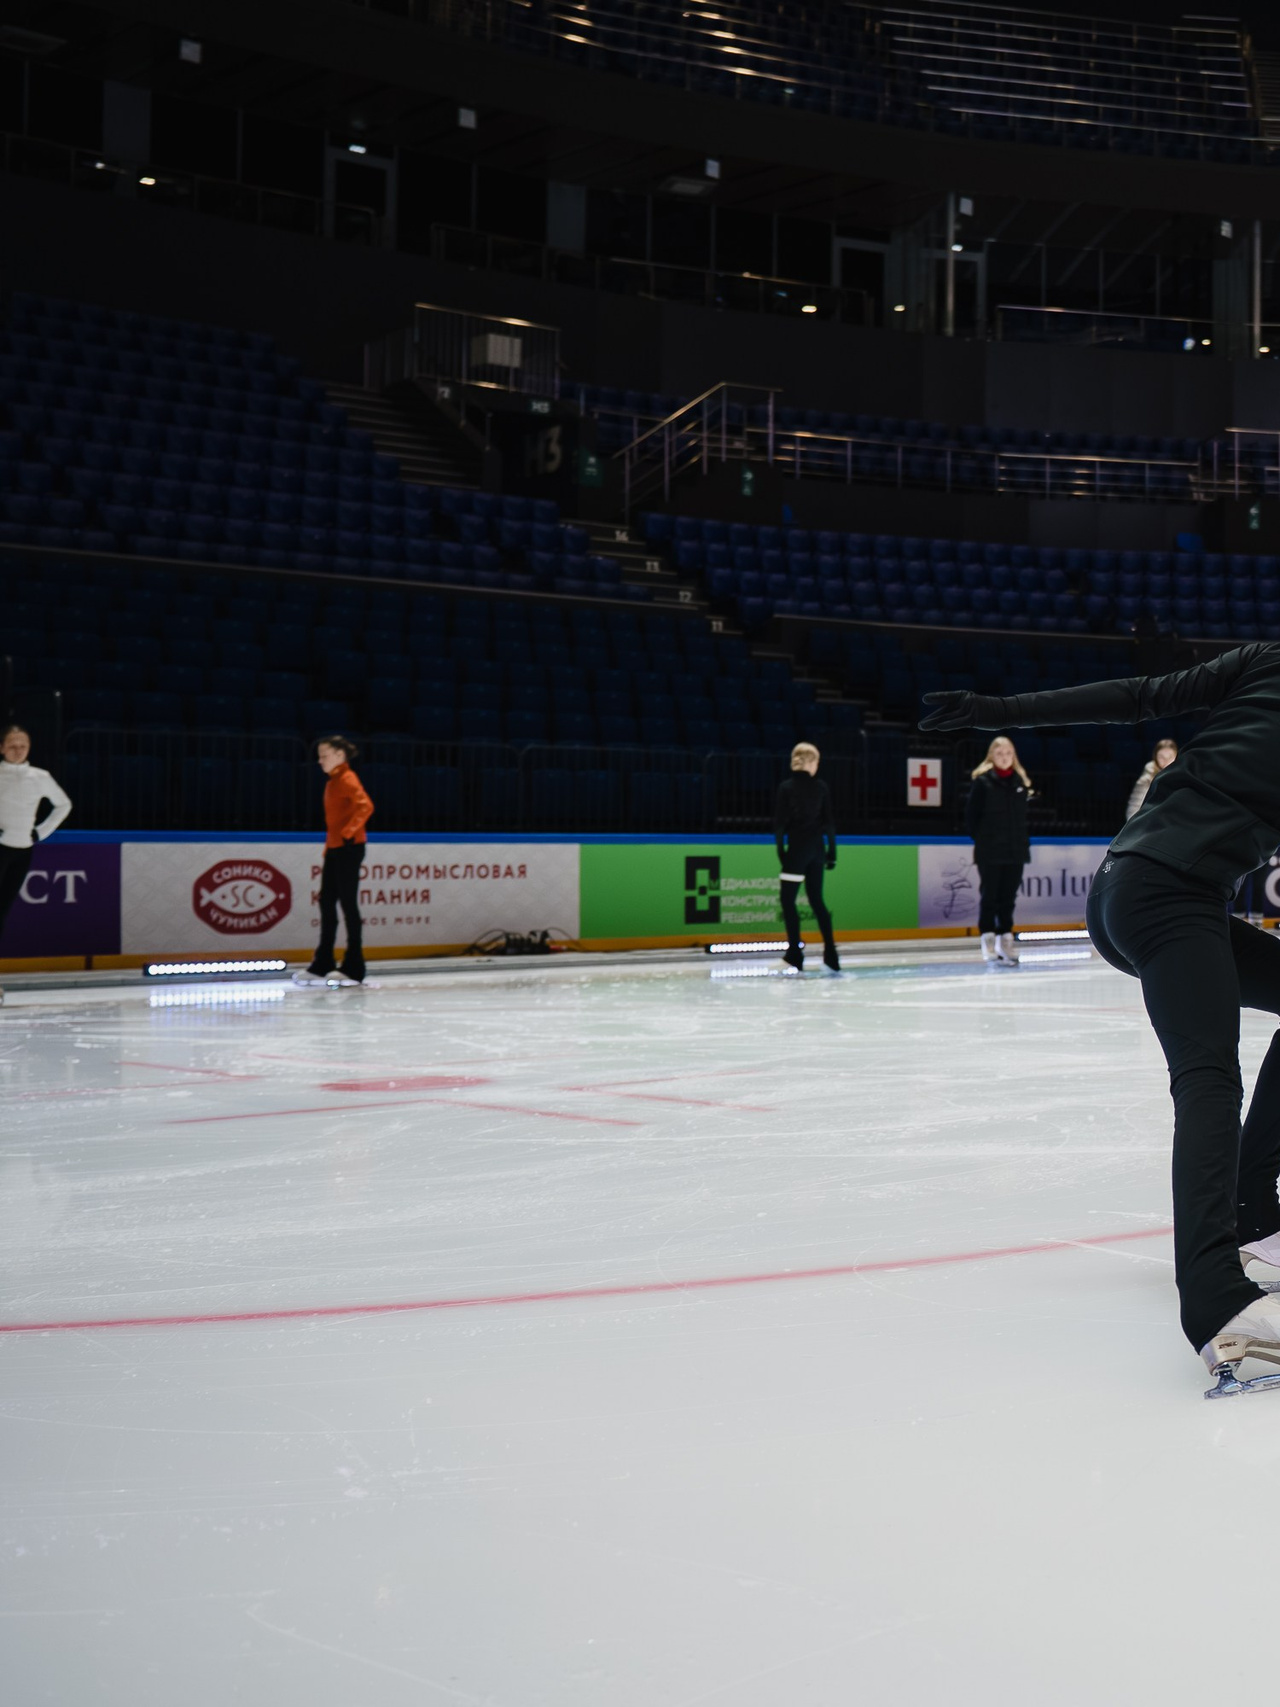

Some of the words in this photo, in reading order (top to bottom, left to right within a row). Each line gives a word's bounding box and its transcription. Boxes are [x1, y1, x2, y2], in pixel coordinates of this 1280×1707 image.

[212, 865, 273, 883] СОНИКО
[311, 864, 527, 881] РОПРОМЫСЛОВАЯ
[311, 889, 431, 906] КПАНИЯ
